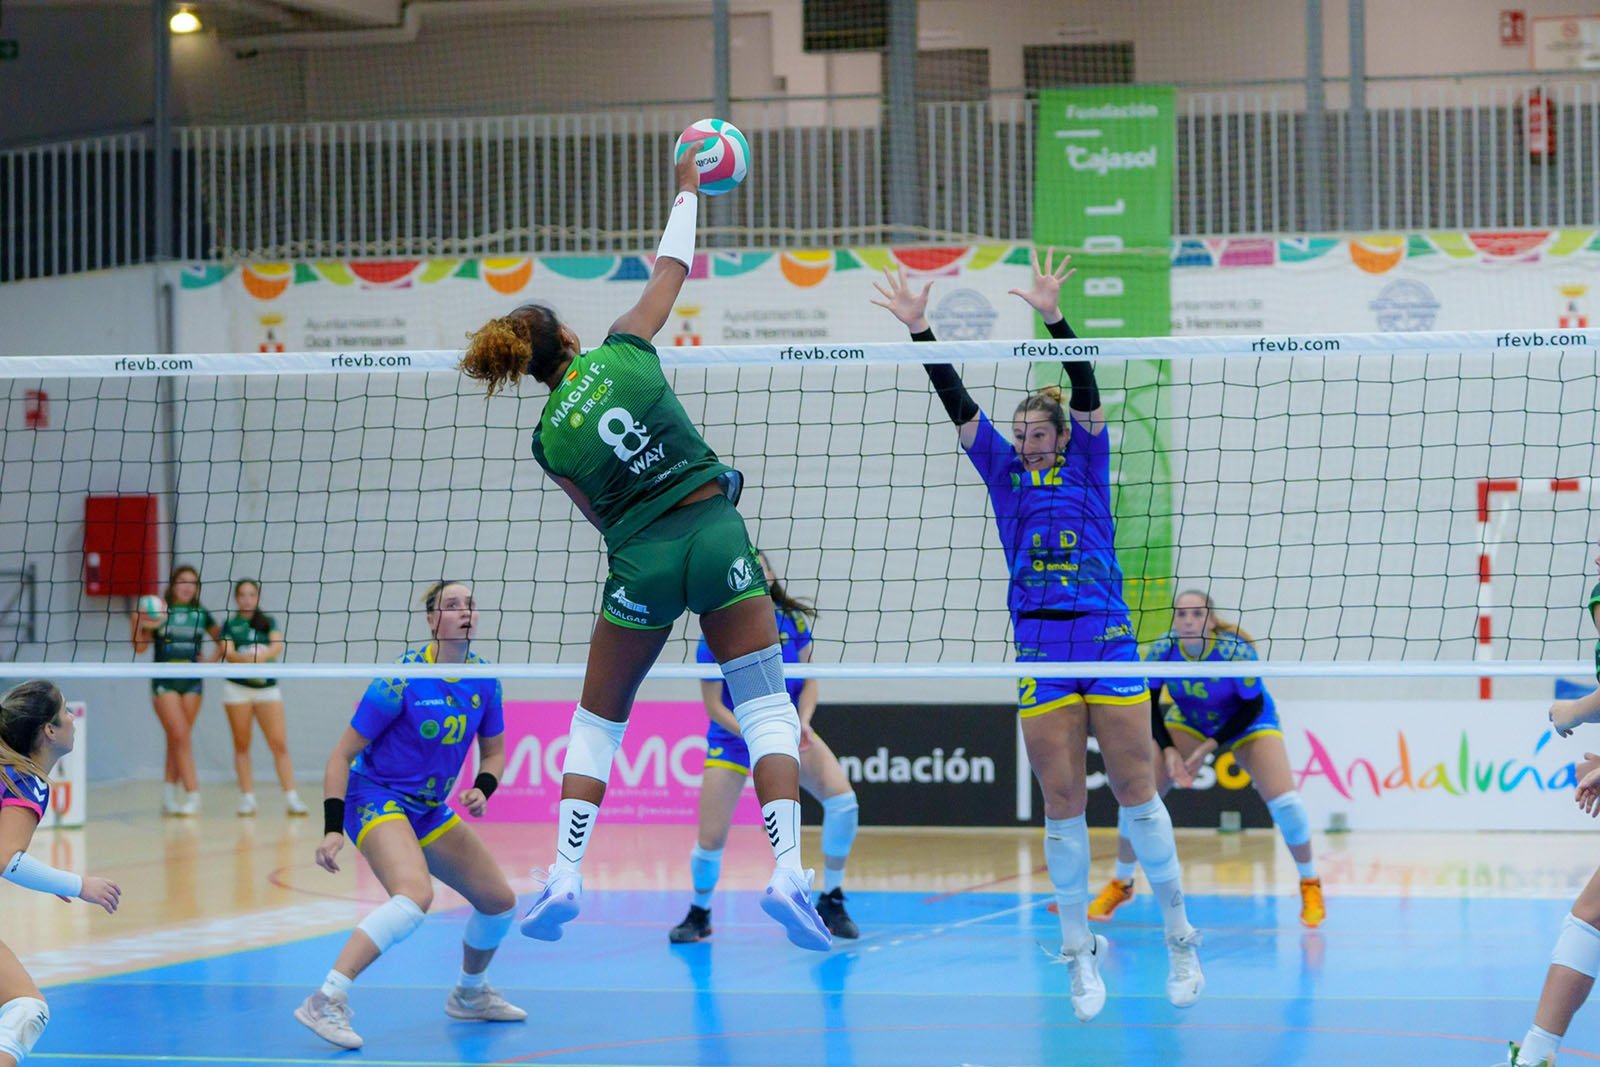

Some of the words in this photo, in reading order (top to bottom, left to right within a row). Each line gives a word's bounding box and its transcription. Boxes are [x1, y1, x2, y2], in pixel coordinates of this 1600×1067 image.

[1065, 145, 1158, 176] Cajasol
[781, 346, 865, 360] rfevb.com
[1013, 342, 1100, 357] rfevb.com
[1252, 337, 1340, 352] rfevb.com
[1497, 331, 1588, 347] rfevb.com
[115, 357, 193, 371] rfevb.com
[331, 353, 411, 368] rfevb.com
[550, 376, 597, 428] MAGUI
[589, 362, 606, 376] F.
[581, 377, 613, 414] ERGOS
[598, 407, 652, 463] 8
[629, 442, 667, 476] WAY
[441, 714, 468, 745] 21
[838, 746, 995, 784] ndación
[1292, 729, 1578, 801] Andalucía
